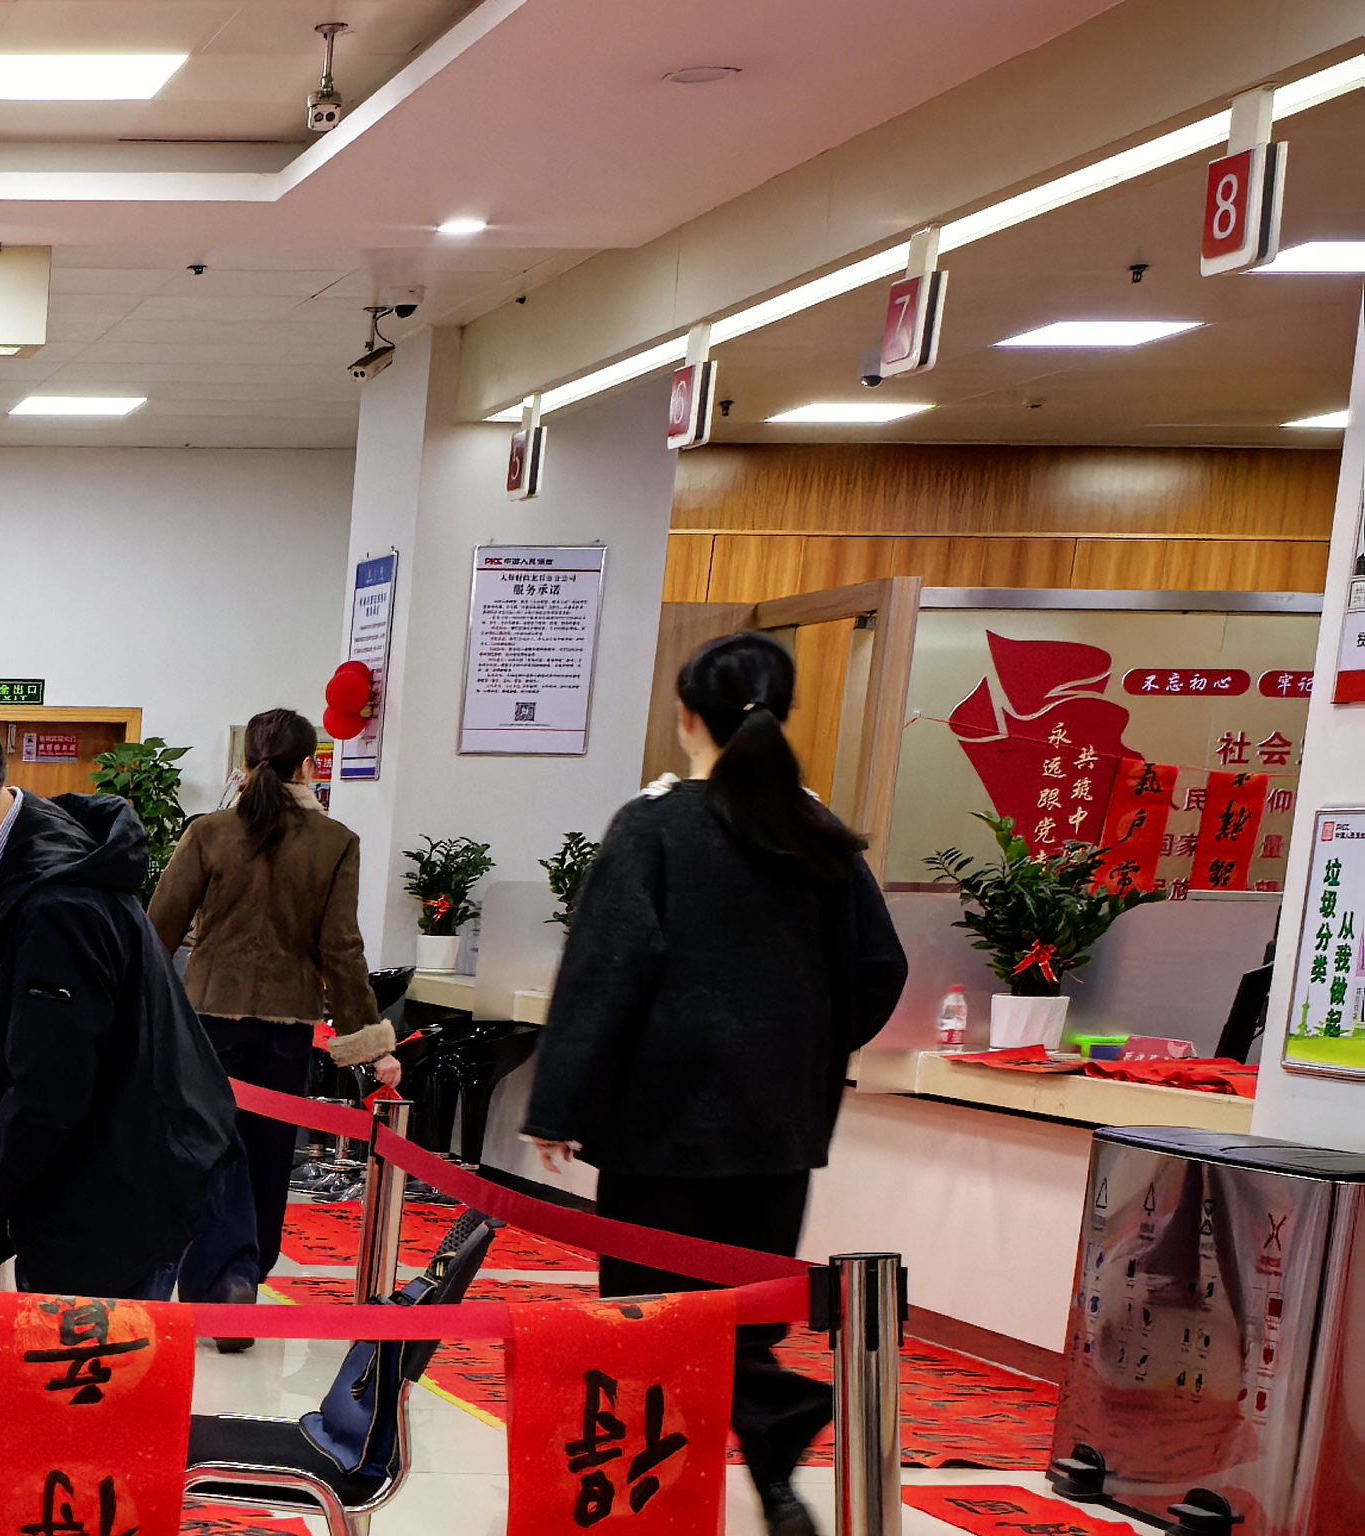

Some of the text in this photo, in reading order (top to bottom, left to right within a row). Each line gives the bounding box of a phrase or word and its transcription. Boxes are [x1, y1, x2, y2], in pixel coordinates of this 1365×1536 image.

[1211, 172, 1238, 242] 8
[891, 293, 913, 343] 7
[512, 583, 562, 597] 服务承诺
[1140, 673, 1234, 693] 不忘初心
[1215, 729, 1304, 768] 社会
